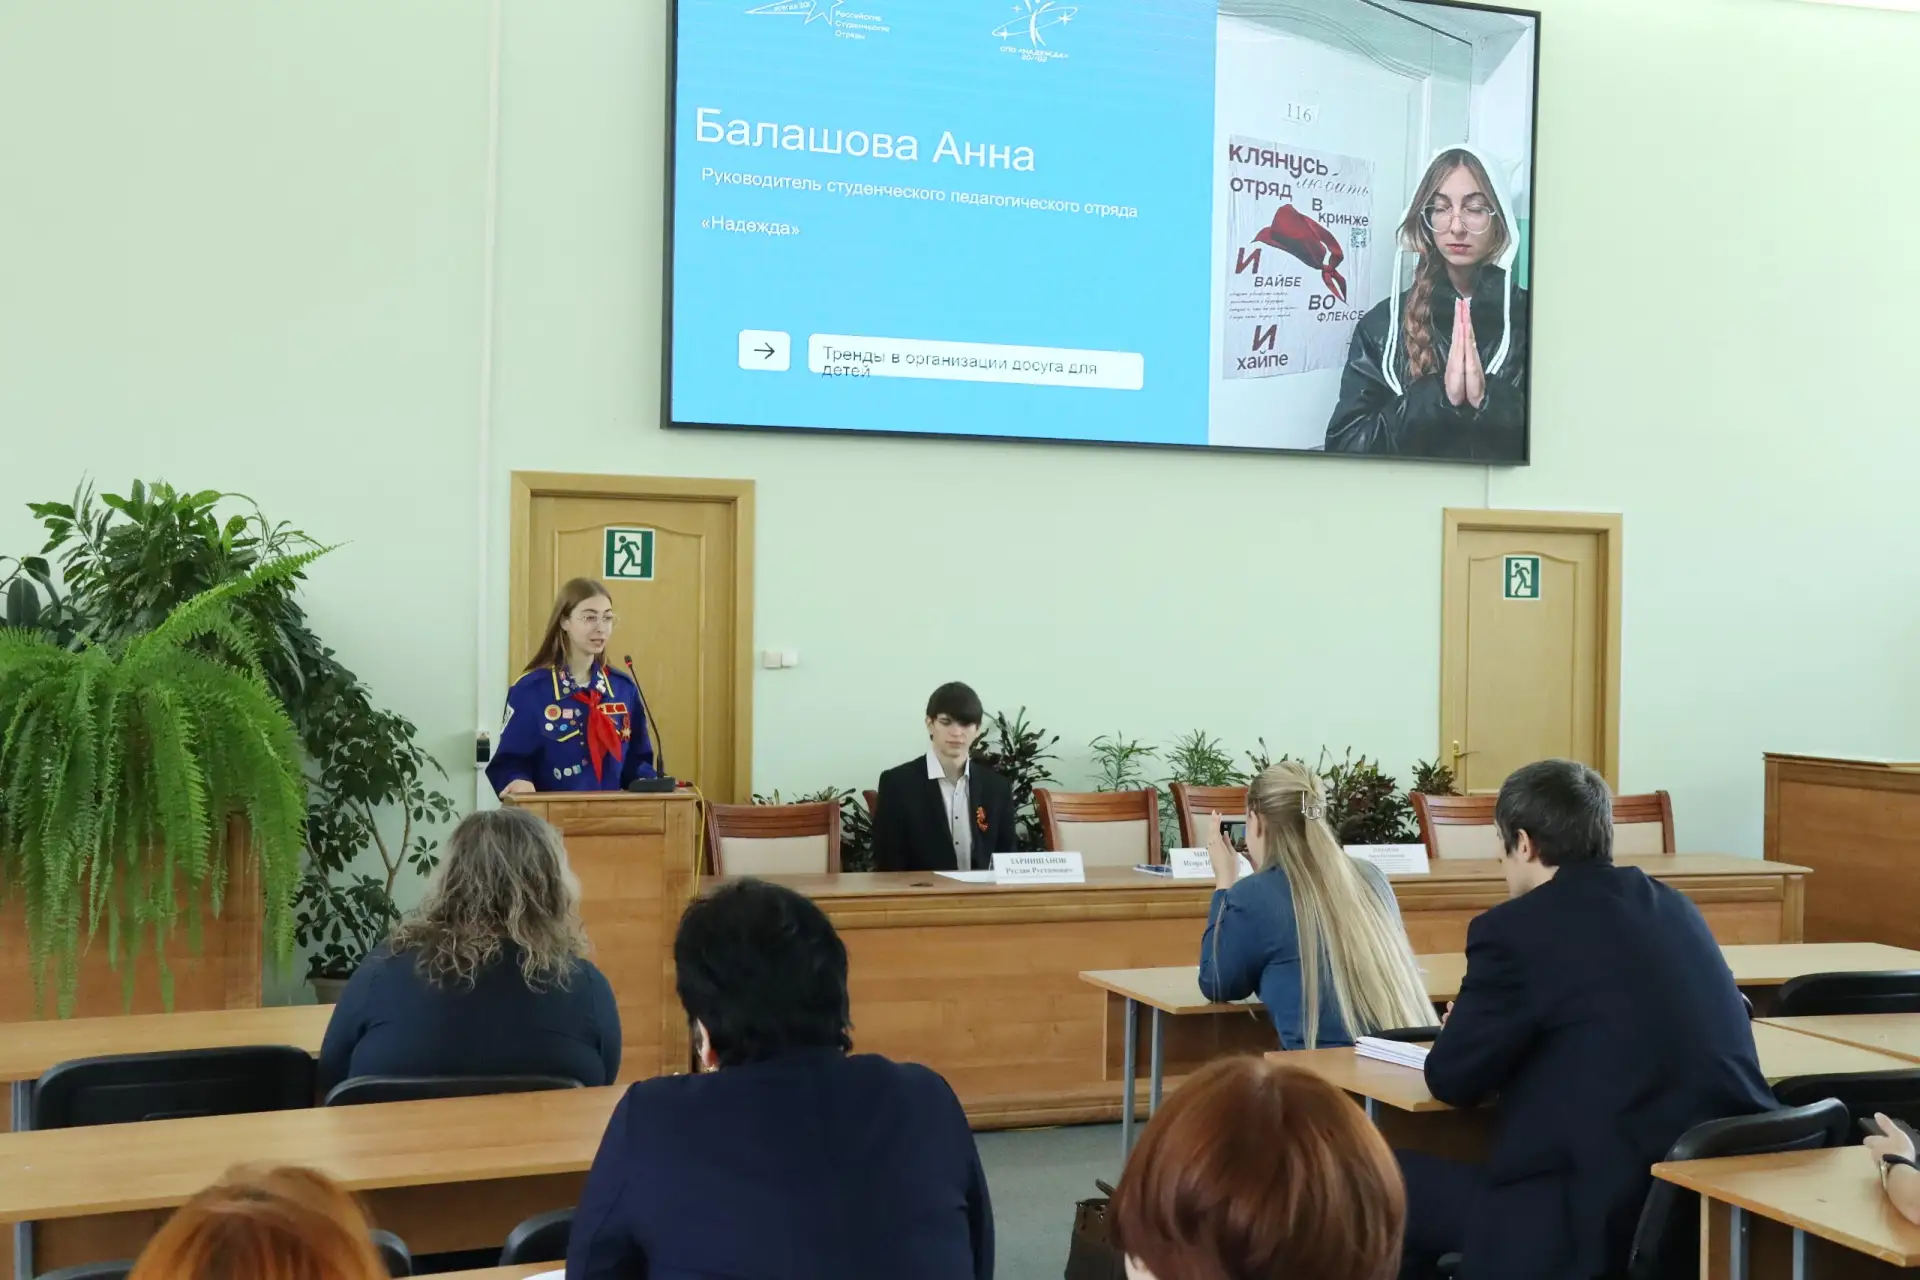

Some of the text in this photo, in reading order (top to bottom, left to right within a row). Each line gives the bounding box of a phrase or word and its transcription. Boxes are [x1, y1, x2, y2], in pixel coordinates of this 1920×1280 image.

[1287, 103, 1312, 122] 116
[696, 106, 1035, 172] Балашова Анна
[701, 167, 1139, 218] Руководитель студенческого педагогического отряда
[1230, 177, 1293, 203] отряд
[701, 215, 800, 236] «Надежда»
[1318, 212, 1369, 228] кринже
[1254, 274, 1302, 287] ВАЙБЕ
[1308, 294, 1336, 310] ВО
[823, 346, 1097, 375] Тренды в организации досуга для
[1237, 350, 1289, 370] хайпе
[822, 363, 871, 378] детей
